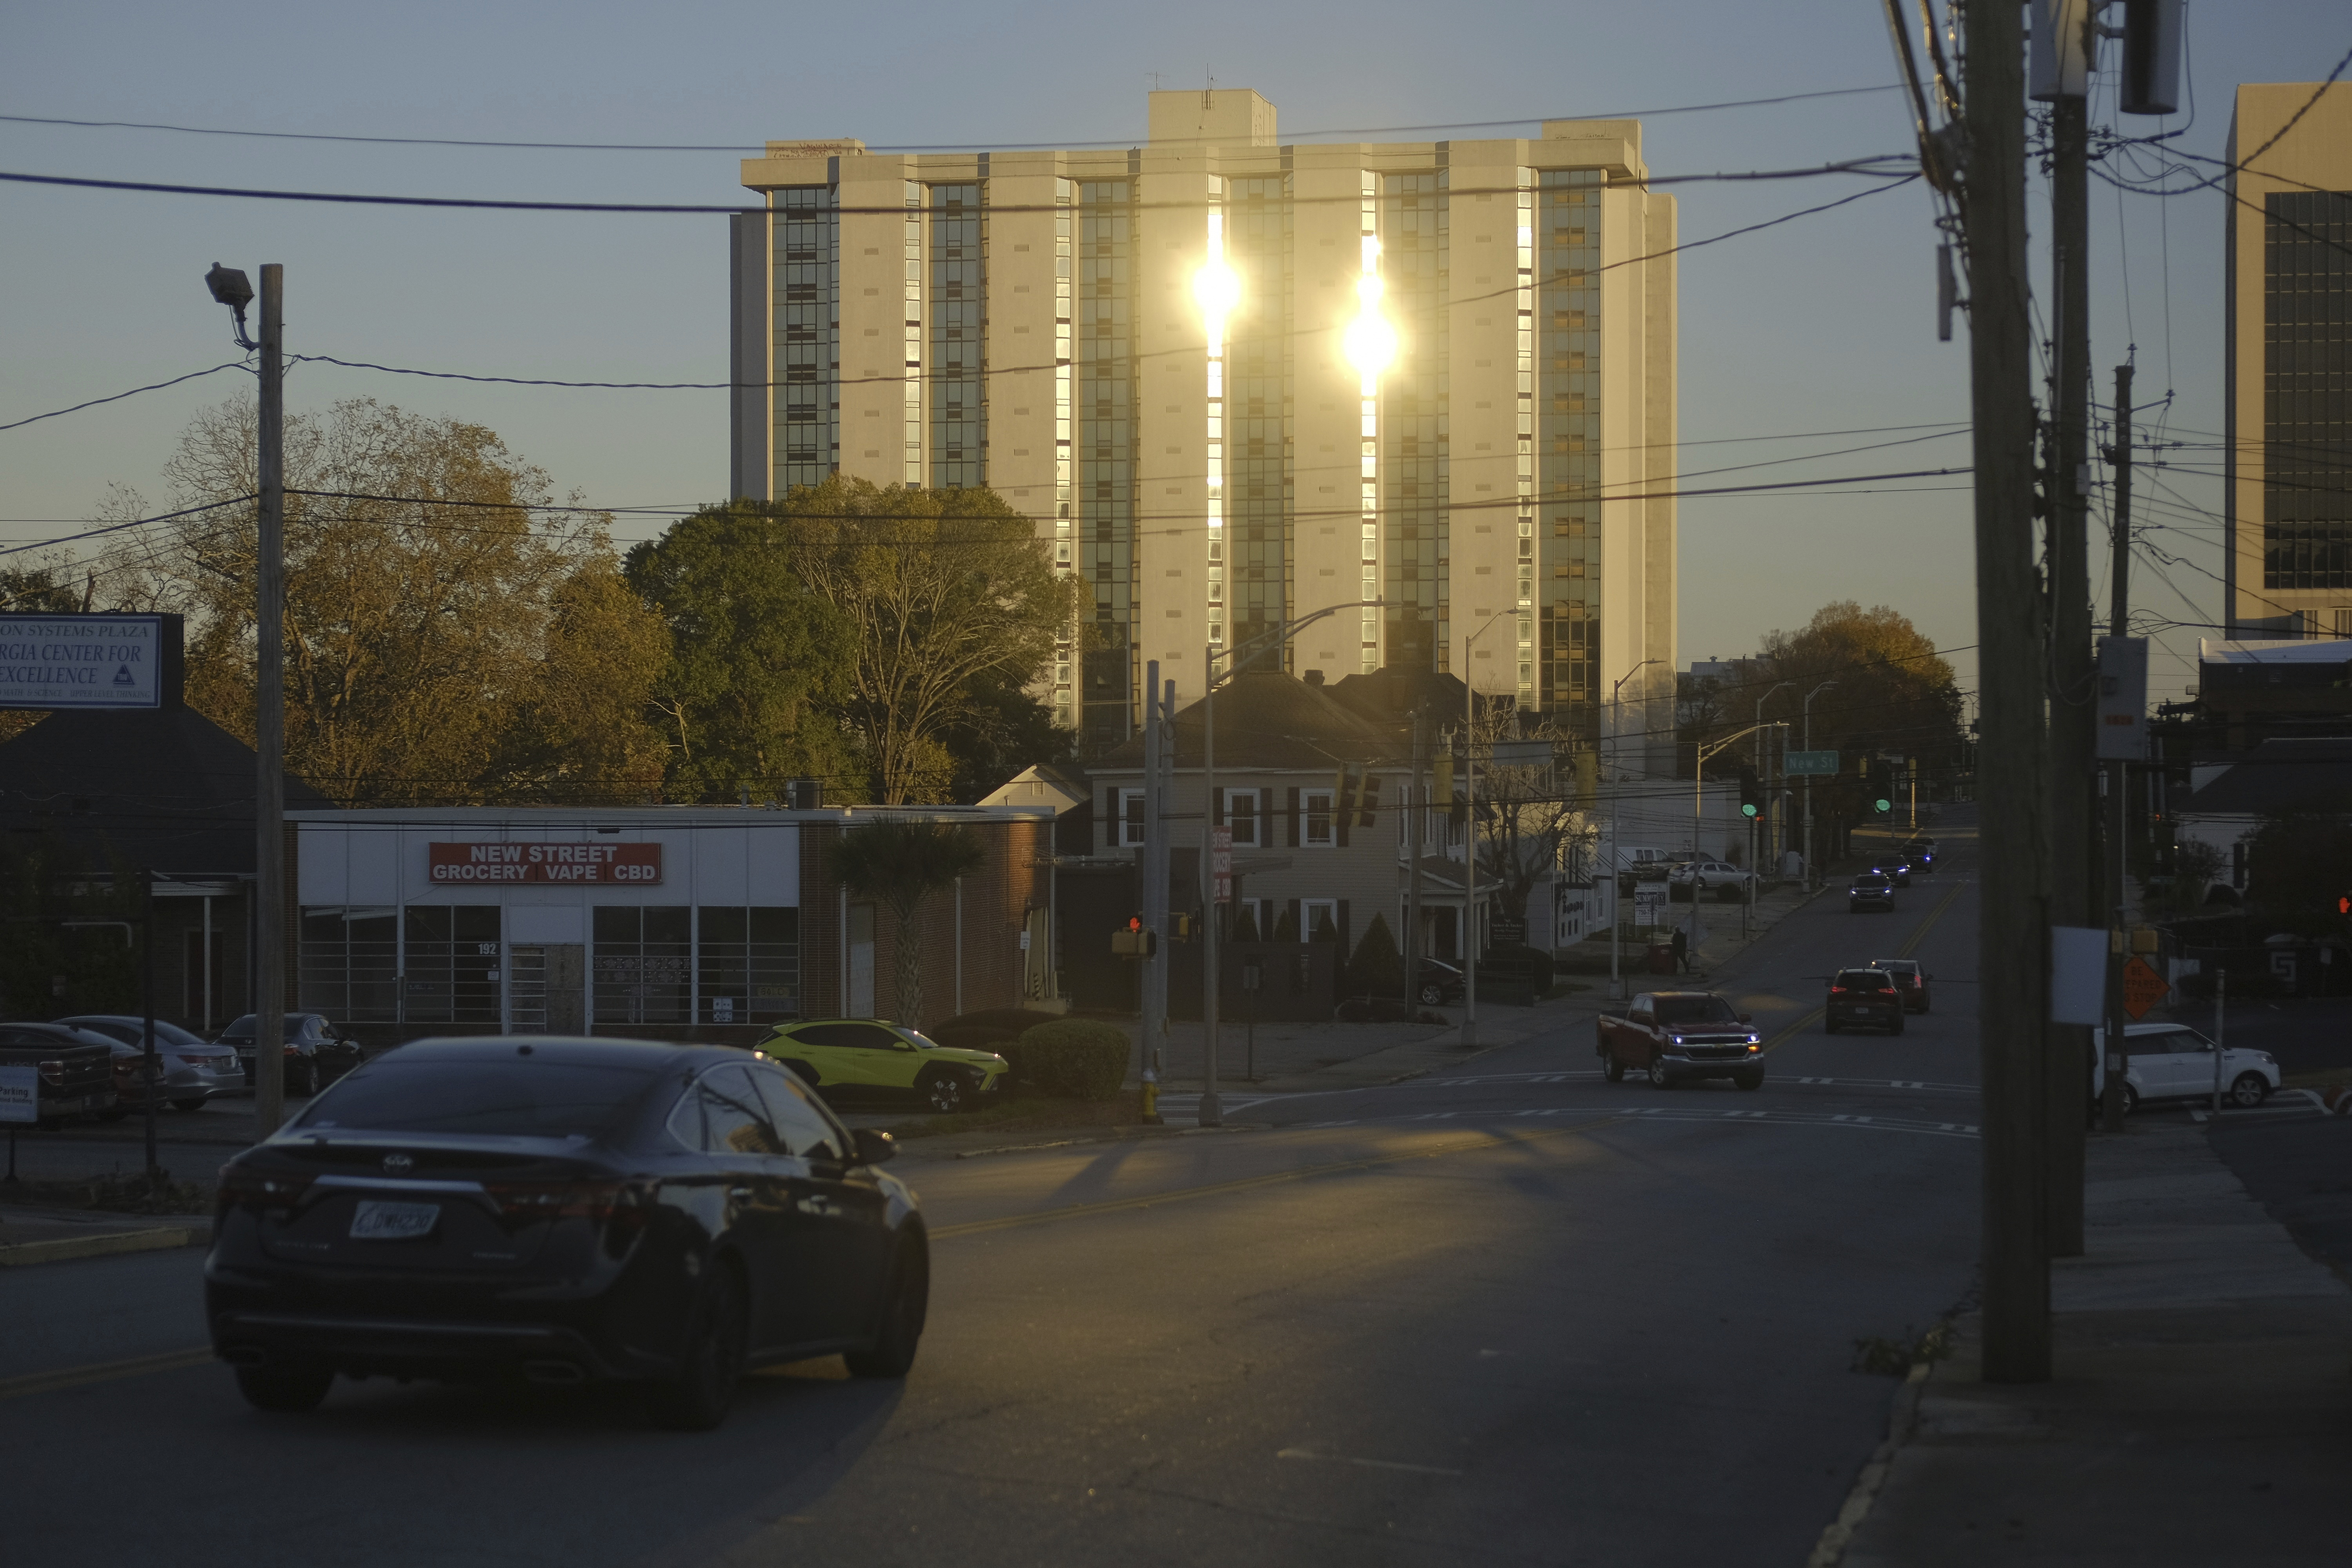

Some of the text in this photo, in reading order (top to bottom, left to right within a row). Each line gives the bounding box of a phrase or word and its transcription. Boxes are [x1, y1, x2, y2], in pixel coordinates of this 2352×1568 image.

[28, 625, 93, 637] SYSTEMS
[98, 626, 148, 637] PLAZA
[42, 644, 103, 661] CENTER
[108, 646, 141, 662] FOR
[34, 689, 62, 697] SCIENCE
[116, 690, 151, 698] THINKING
[1789, 757, 1833, 769] New St
[470, 846, 617, 862] NEW STREET
[433, 865, 655, 880] GROCERY VAPE CBD
[478, 943, 496, 955] 192
[2131, 966, 2143, 976] BE
[2125, 979, 2161, 989] EPARED
[2134, 992, 2157, 1002] STOP
